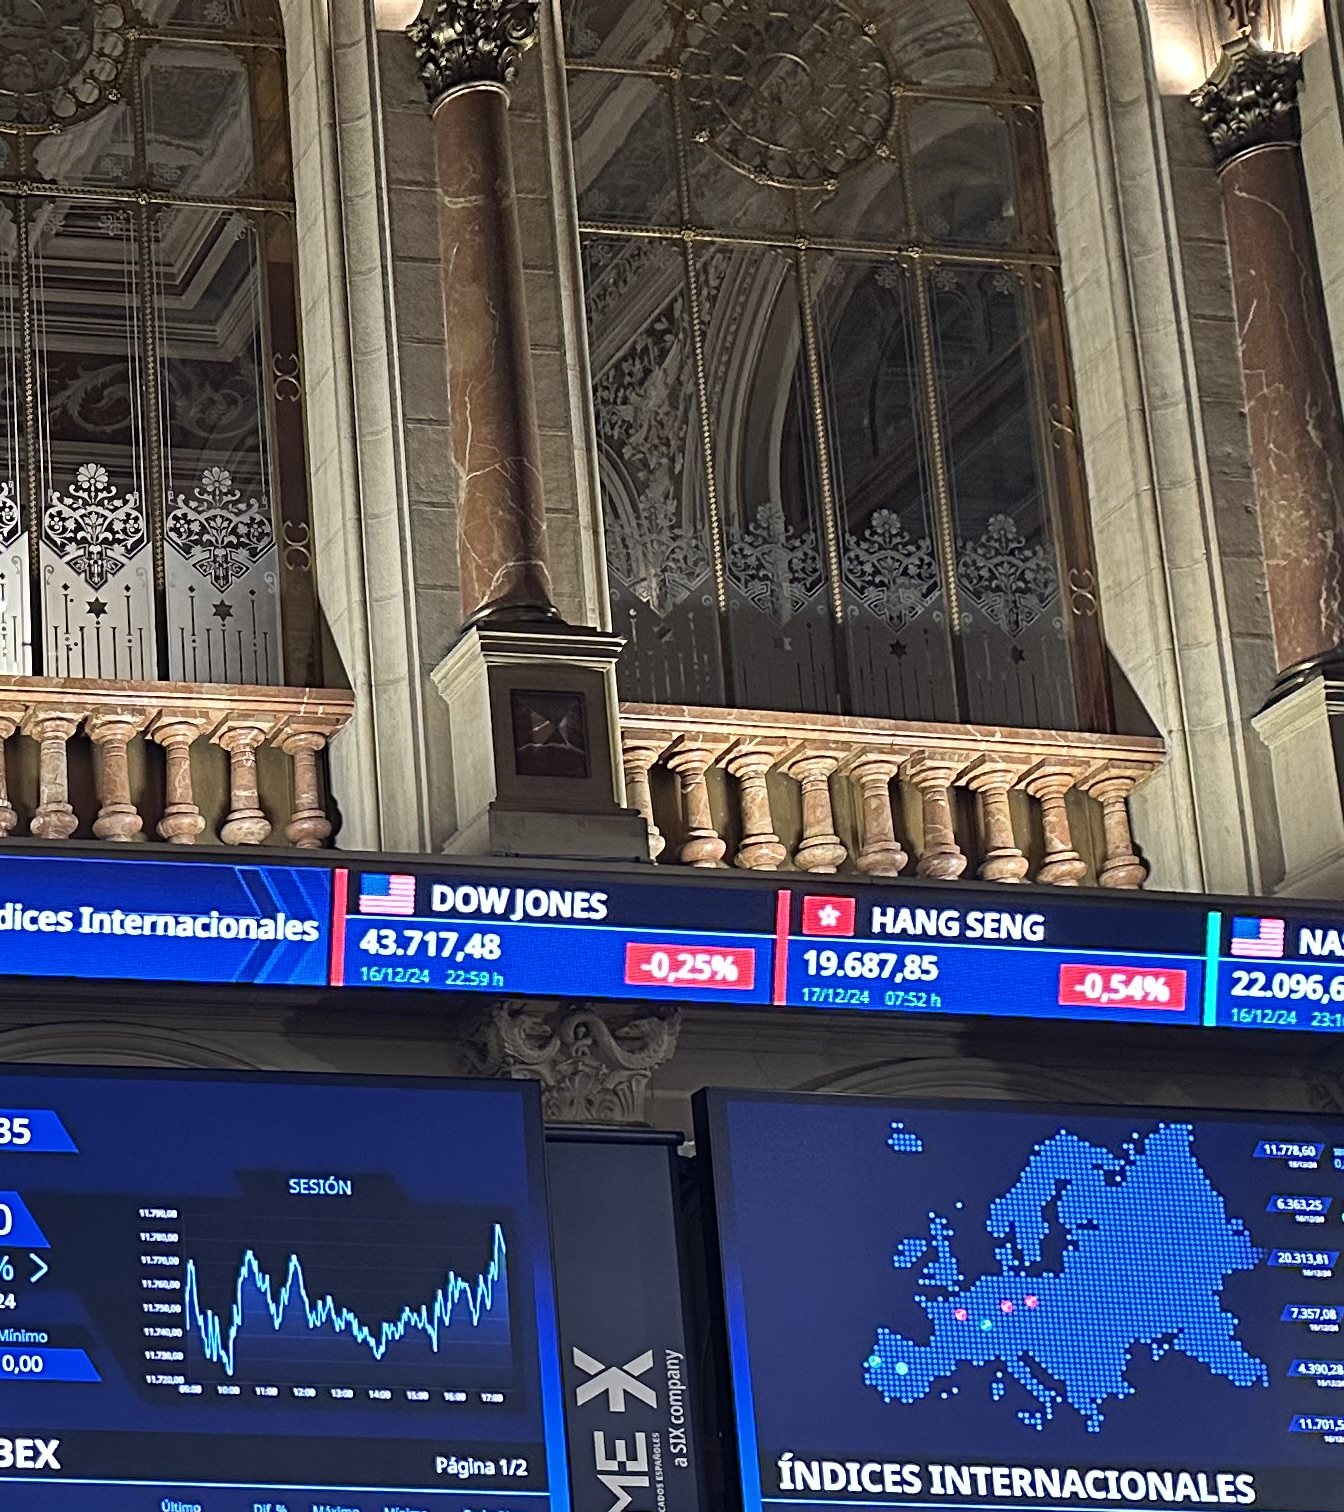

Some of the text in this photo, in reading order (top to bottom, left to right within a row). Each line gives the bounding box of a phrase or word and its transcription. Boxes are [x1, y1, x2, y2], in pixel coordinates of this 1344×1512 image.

[432, 884, 608, 920] DOW JONES
[77, 907, 319, 941] Internacionales
[872, 907, 1045, 941] HANG SENG
[360, 929, 501, 962] 43.717,48
[1299, 928, 1344, 956] NA
[641, 952, 738, 982] -0,25%
[804, 950, 939, 983] 19.687,85
[1071, 973, 1170, 1004] -0,54%
[289, 1176, 351, 1195] SESIÓN
[2, 1355, 43, 1374] 0,00
[436, 1457, 528, 1478] Página 1/2
[778, 1452, 1255, 1503] ÍNDICES INTERNACIONALES
